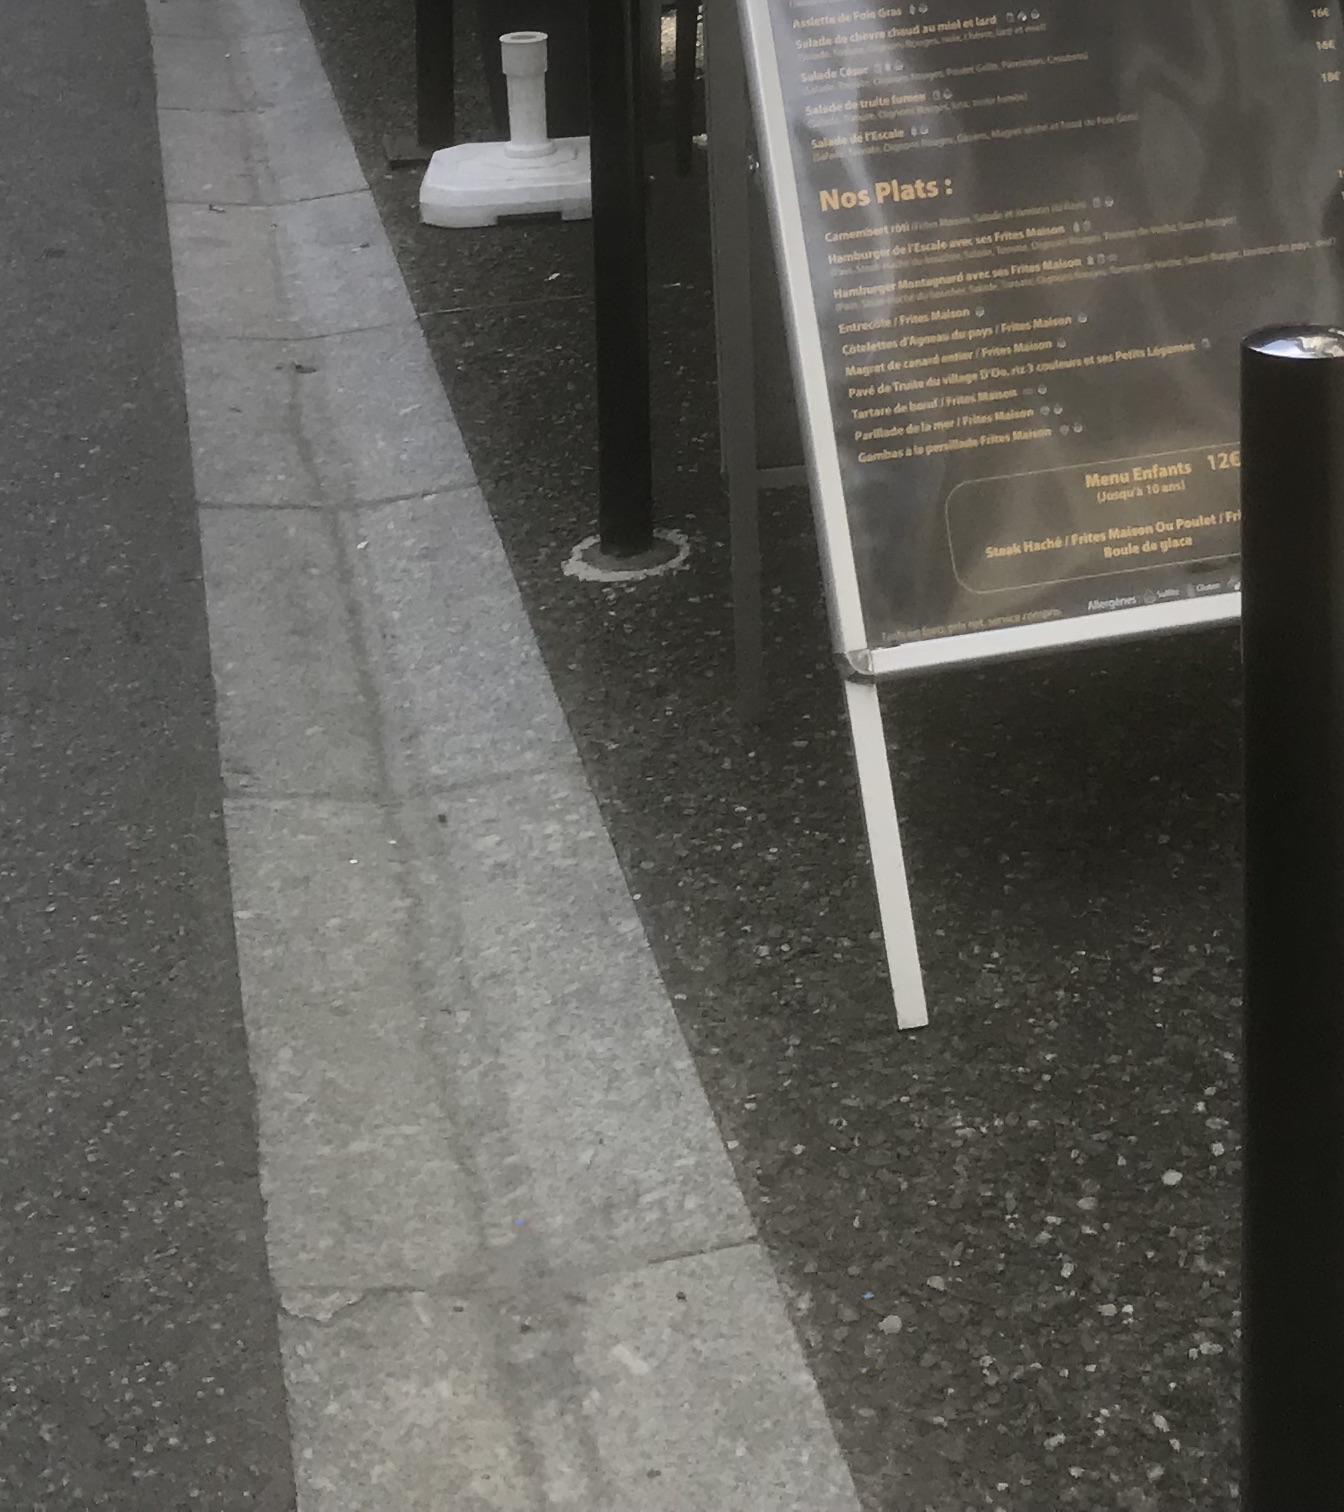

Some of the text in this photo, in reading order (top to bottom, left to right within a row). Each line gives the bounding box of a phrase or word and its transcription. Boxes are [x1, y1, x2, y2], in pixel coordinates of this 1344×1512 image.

[795, 36, 832, 49] Salade
[834, 33, 847, 44] de
[962, 17, 974, 28] et
[975, 15, 997, 25] lard
[800, 69, 837, 81] Salade
[805, 103, 842, 115] Salade
[810, 136, 847, 148] Salade
[819, 186, 870, 211] Nos
[874, 176, 939, 203] Plats
[828, 247, 890, 264] Hamburger
[833, 283, 897, 300] Hamburger
[899, 313, 929, 325] Frites
[848, 386, 875, 399] Pavé
[1084, 470, 1130, 488] Menu
[1132, 459, 1193, 481] Enfants
[984, 542, 1022, 558] Steak
[1022, 536, 1063, 553] Haché
[1069, 530, 1107, 546] Frites
[1107, 523, 1155, 540] Maison
[1155, 518, 1175, 534] Ou
[1174, 514, 1217, 530] Poulet
[1103, 543, 1140, 558] Boule
[1160, 536, 1194, 553] glace
